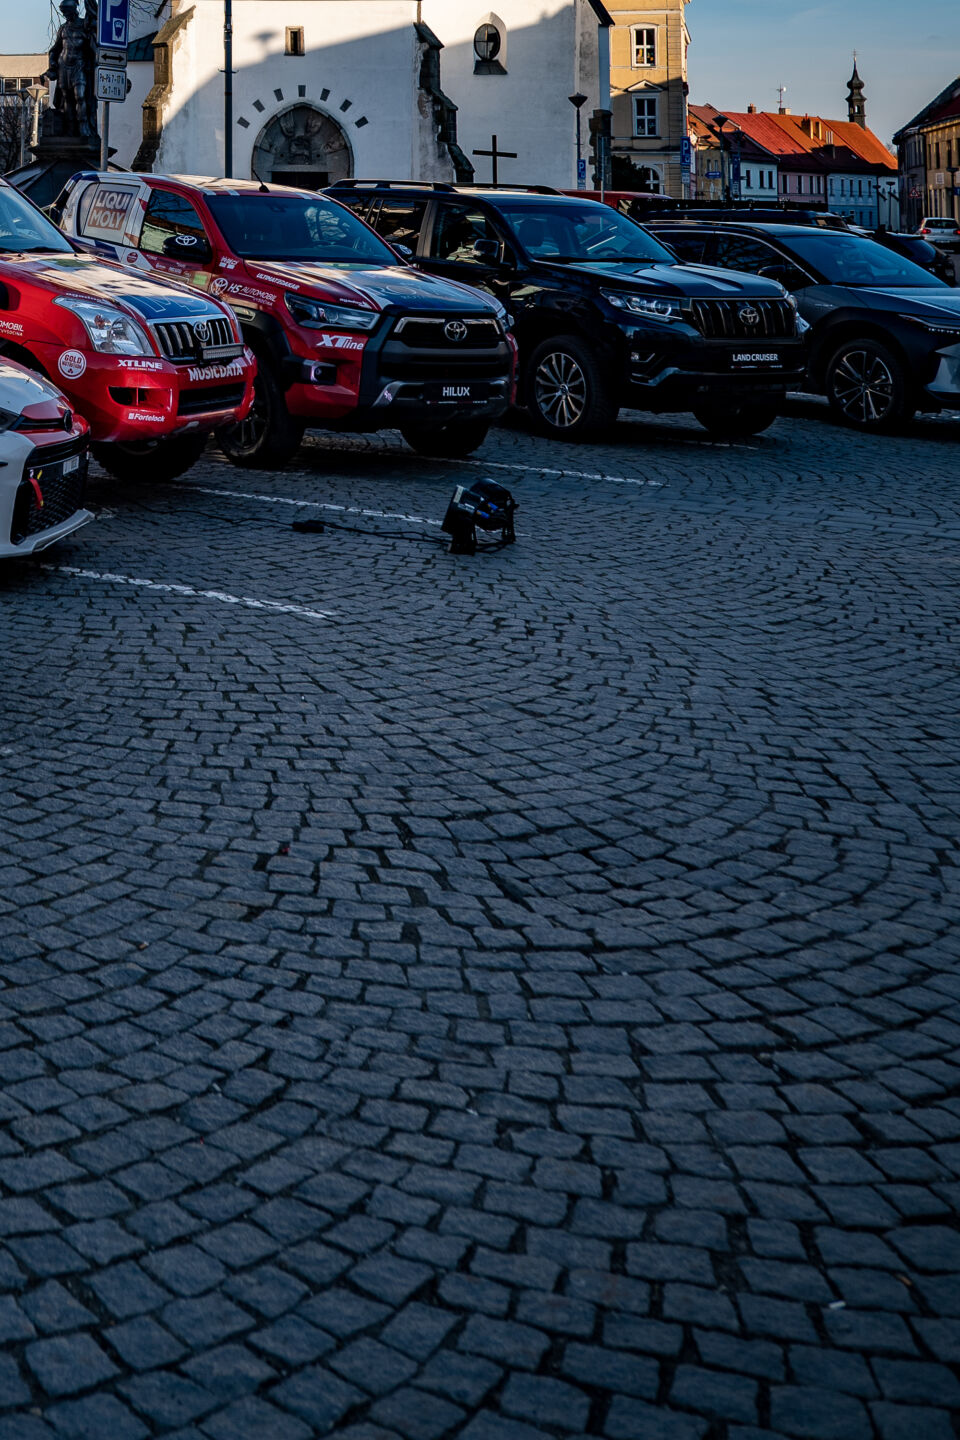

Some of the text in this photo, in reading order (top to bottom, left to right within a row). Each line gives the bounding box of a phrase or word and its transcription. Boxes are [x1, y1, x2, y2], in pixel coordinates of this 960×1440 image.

[683, 140, 688, 155] P
[95, 191, 132, 210] LIQUI
[89, 210, 125, 228] MOLY
[227, 283, 277, 302] HS AUTOMOBIL
[316, 334, 364, 350] XTline
[64, 354, 82, 363] GOLD
[118, 359, 163, 370] XTLINE
[732, 353, 778, 361] LAND CRUISER
[188, 363, 244, 381] MUSICDATA
[442, 386, 470, 397] HILUX
[135, 413, 165, 422] Fortelock
